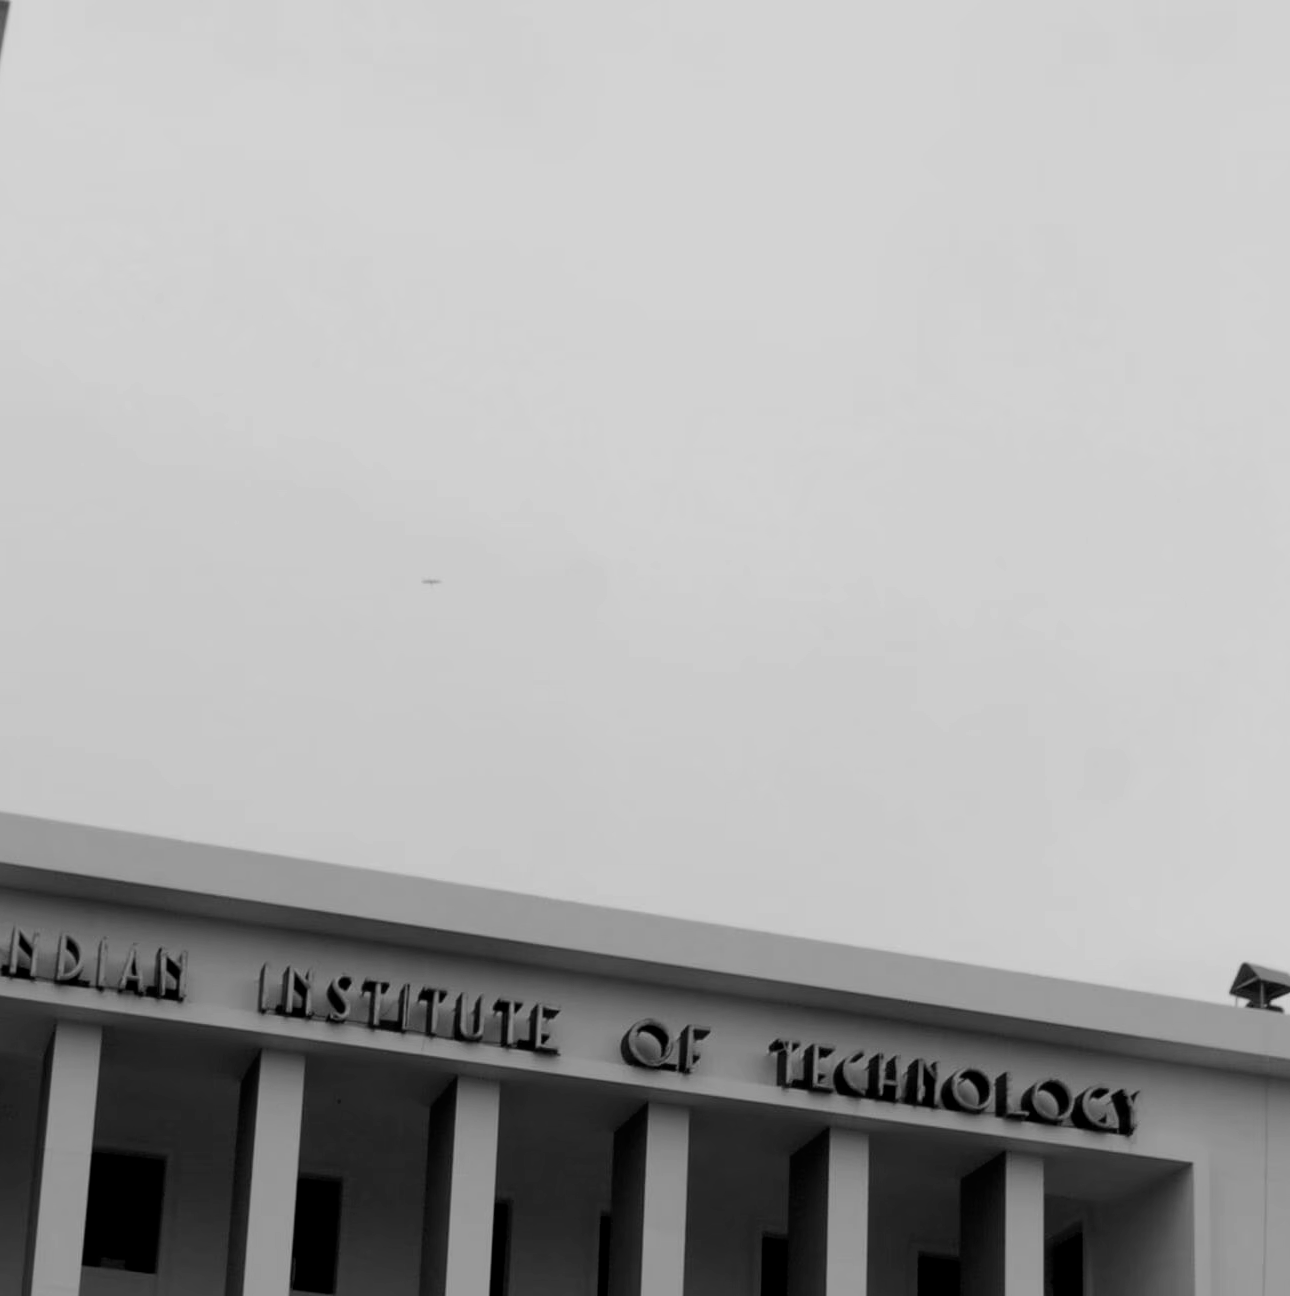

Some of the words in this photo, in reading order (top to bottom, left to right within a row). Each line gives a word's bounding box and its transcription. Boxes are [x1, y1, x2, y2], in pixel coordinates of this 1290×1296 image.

[259, 961, 561, 1056] INSTITUTE
[620, 1017, 711, 1074] OF
[768, 1038, 1140, 1136] TECHNOLOGY
